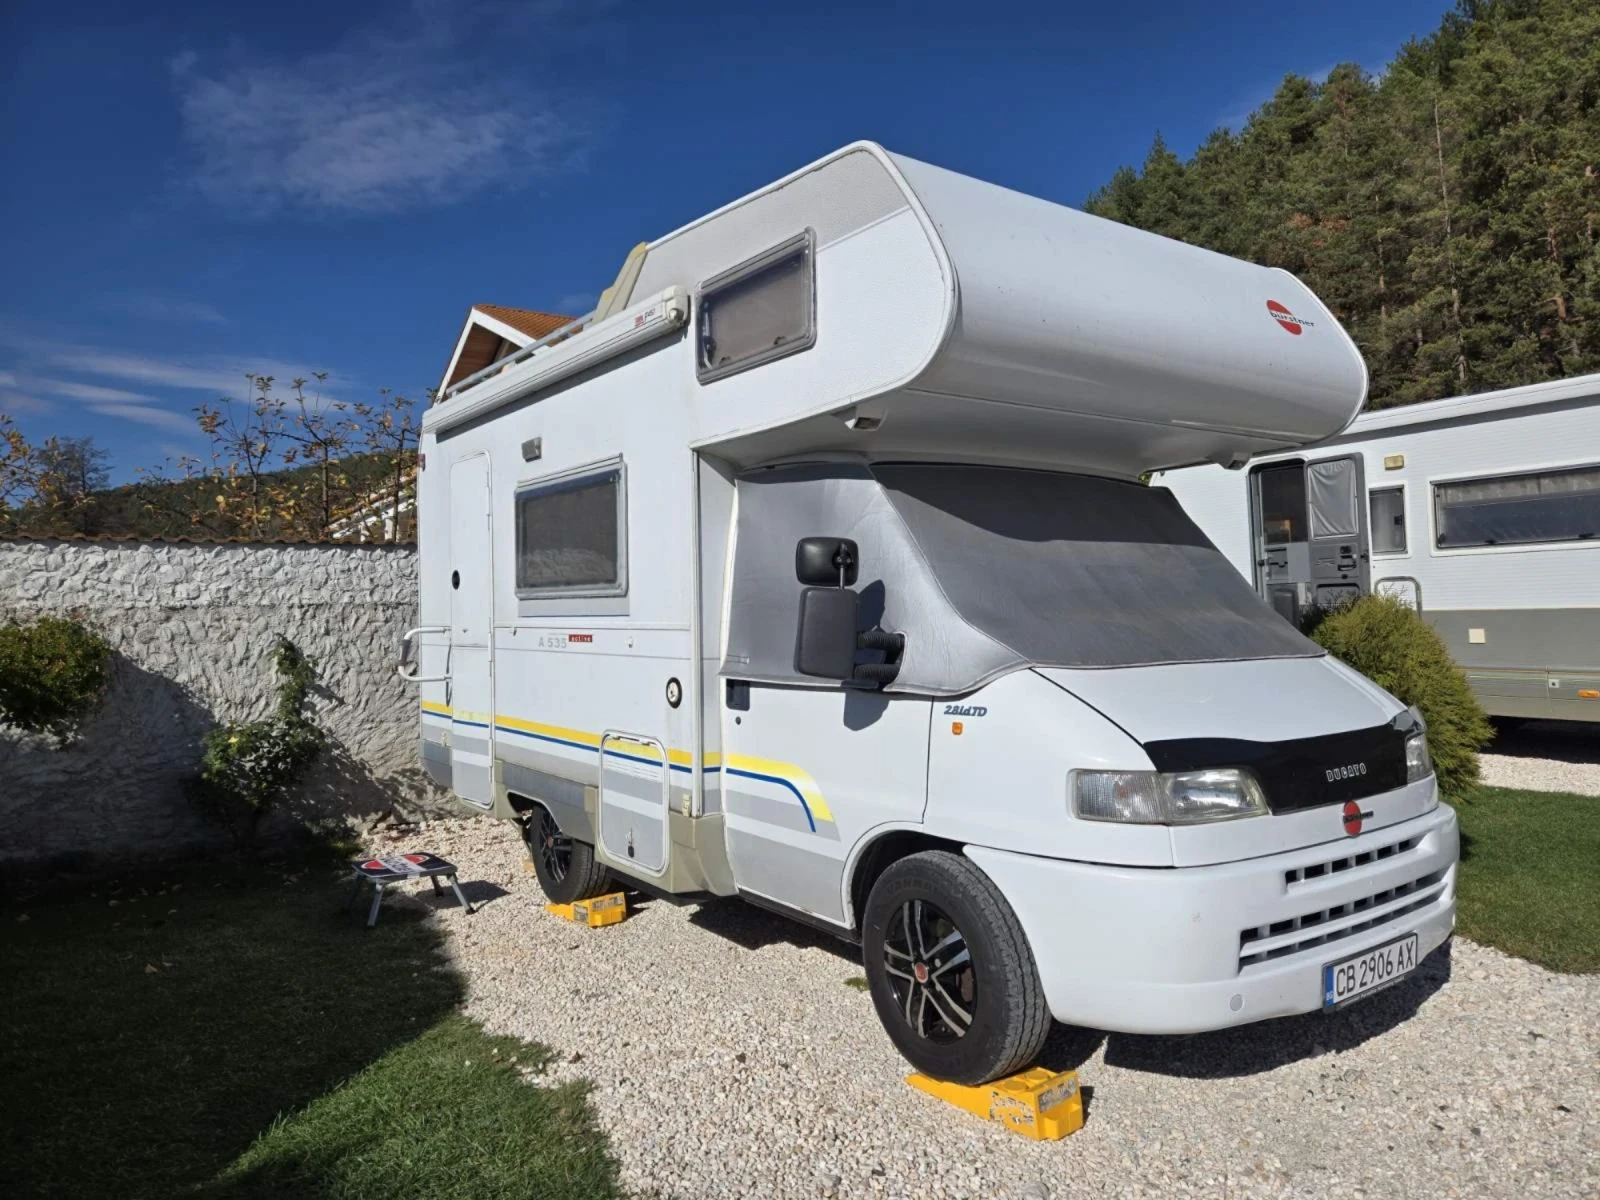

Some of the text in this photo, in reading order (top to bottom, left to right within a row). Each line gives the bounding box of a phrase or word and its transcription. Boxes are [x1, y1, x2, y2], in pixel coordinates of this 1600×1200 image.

[538, 636, 545, 648] A
[547, 637, 567, 649] 535
[1325, 762, 1368, 782] DUCATO
[1336, 964, 1356, 997] CB
[1359, 949, 1394, 988] 2906
[1397, 940, 1415, 973] AX
